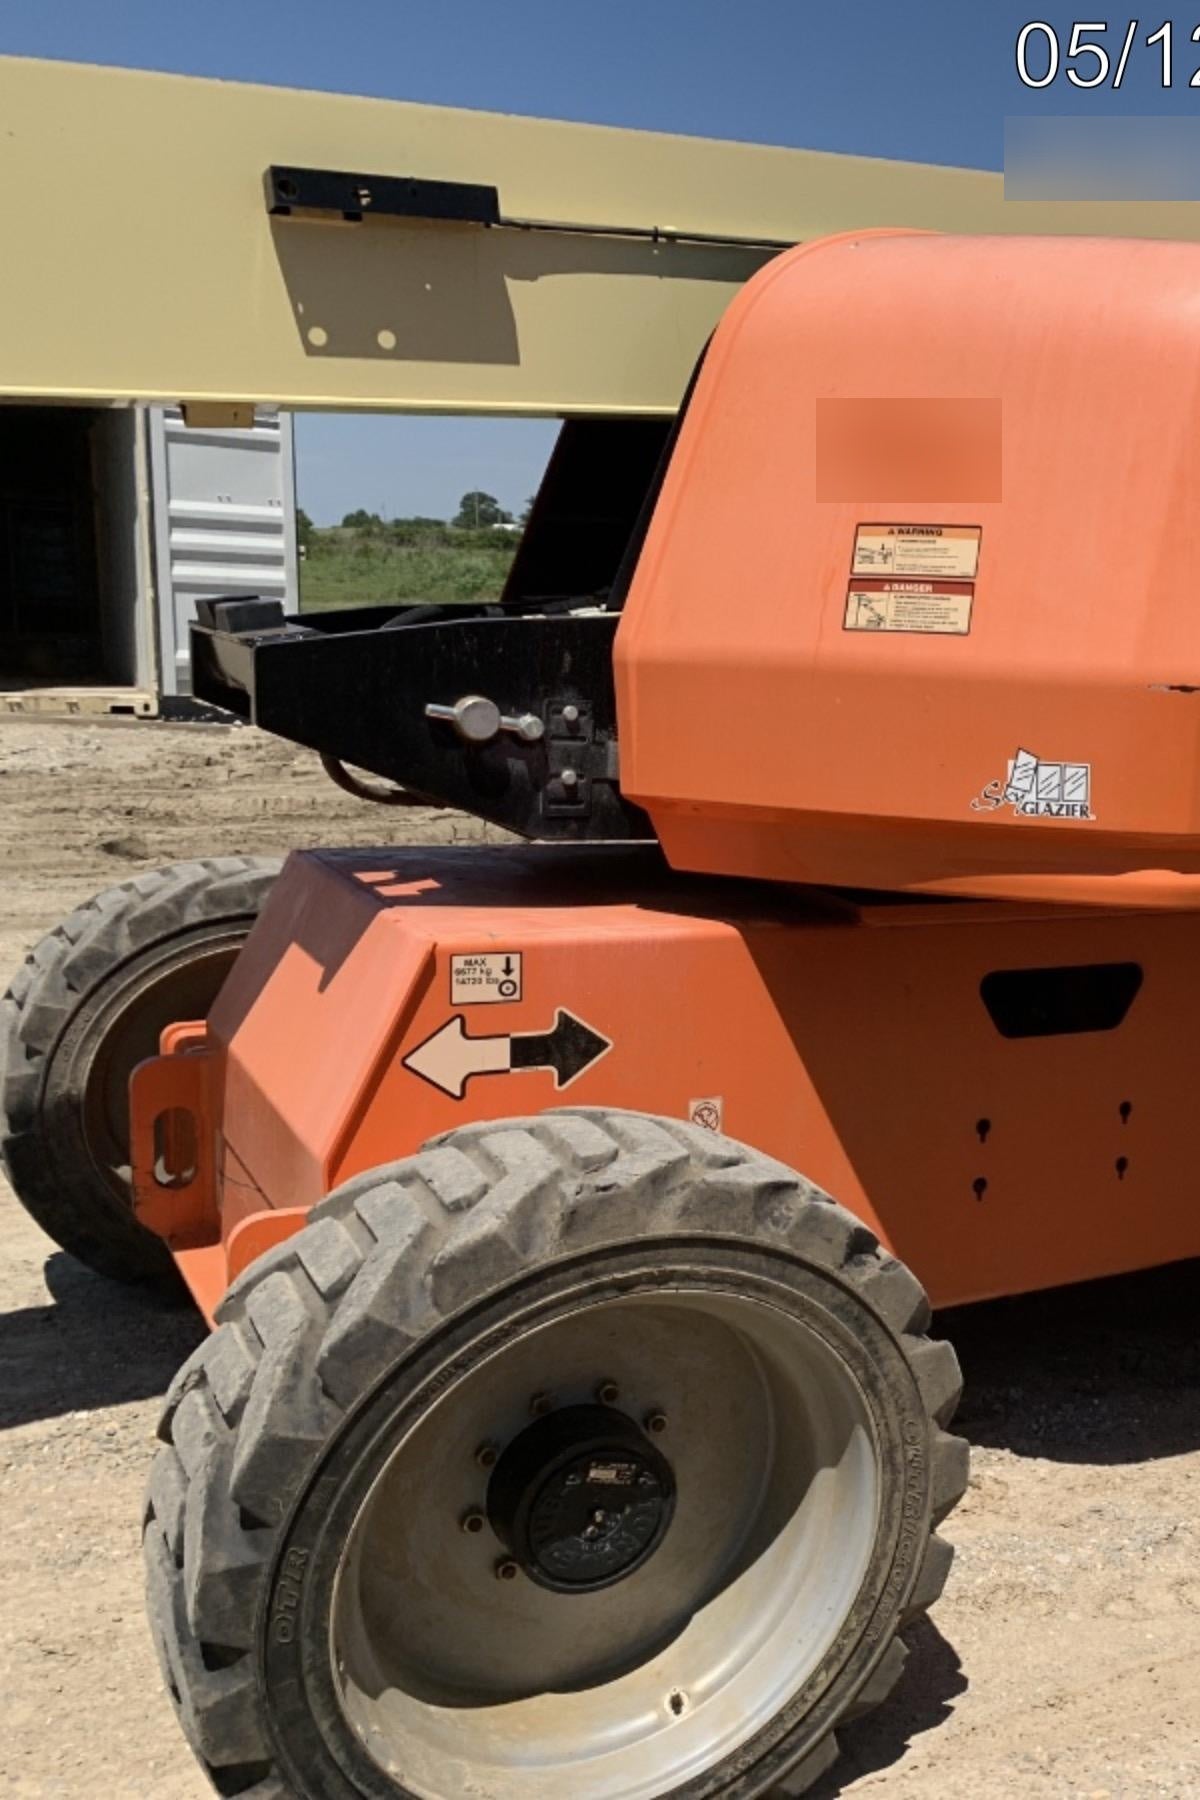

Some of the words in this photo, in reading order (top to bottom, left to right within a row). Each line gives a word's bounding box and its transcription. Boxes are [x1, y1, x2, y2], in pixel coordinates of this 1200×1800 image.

[898, 528, 943, 537] WARNING
[891, 583, 933, 593] DANGER
[1022, 801, 1090, 818] GLAZIER
[464, 957, 487, 966] MAX
